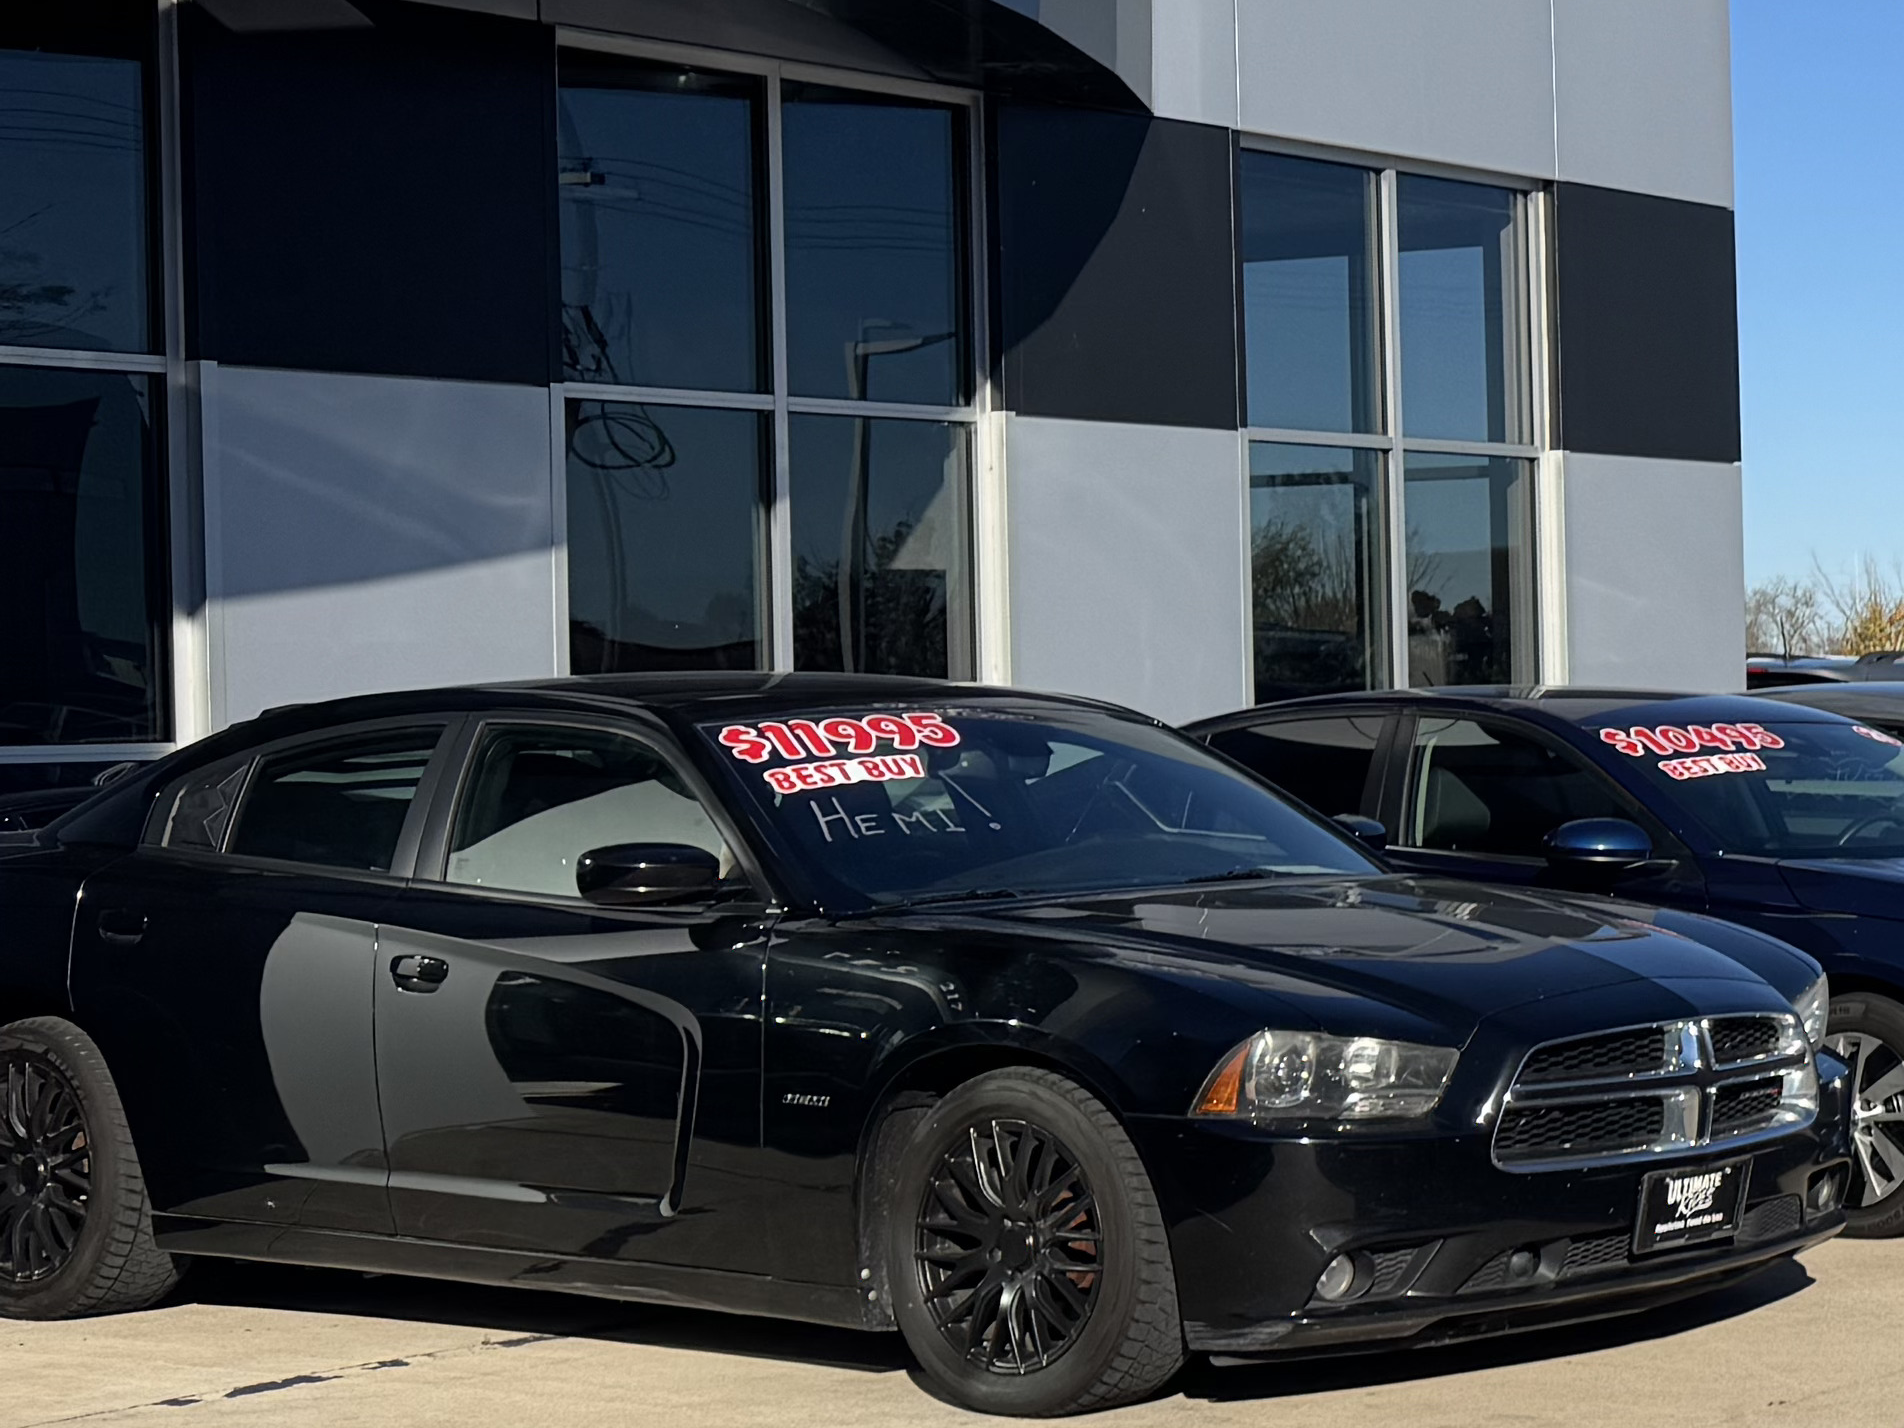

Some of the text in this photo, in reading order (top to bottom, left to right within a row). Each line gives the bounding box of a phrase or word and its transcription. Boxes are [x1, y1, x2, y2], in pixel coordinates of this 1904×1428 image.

[719, 713, 961, 763] $11995
[1600, 722, 1785, 757] $10495
[765, 755, 925, 793] BEST BUY
[1660, 752, 1766, 780] BEST BUY
[1667, 1171, 1723, 1205] ULTIMATE
